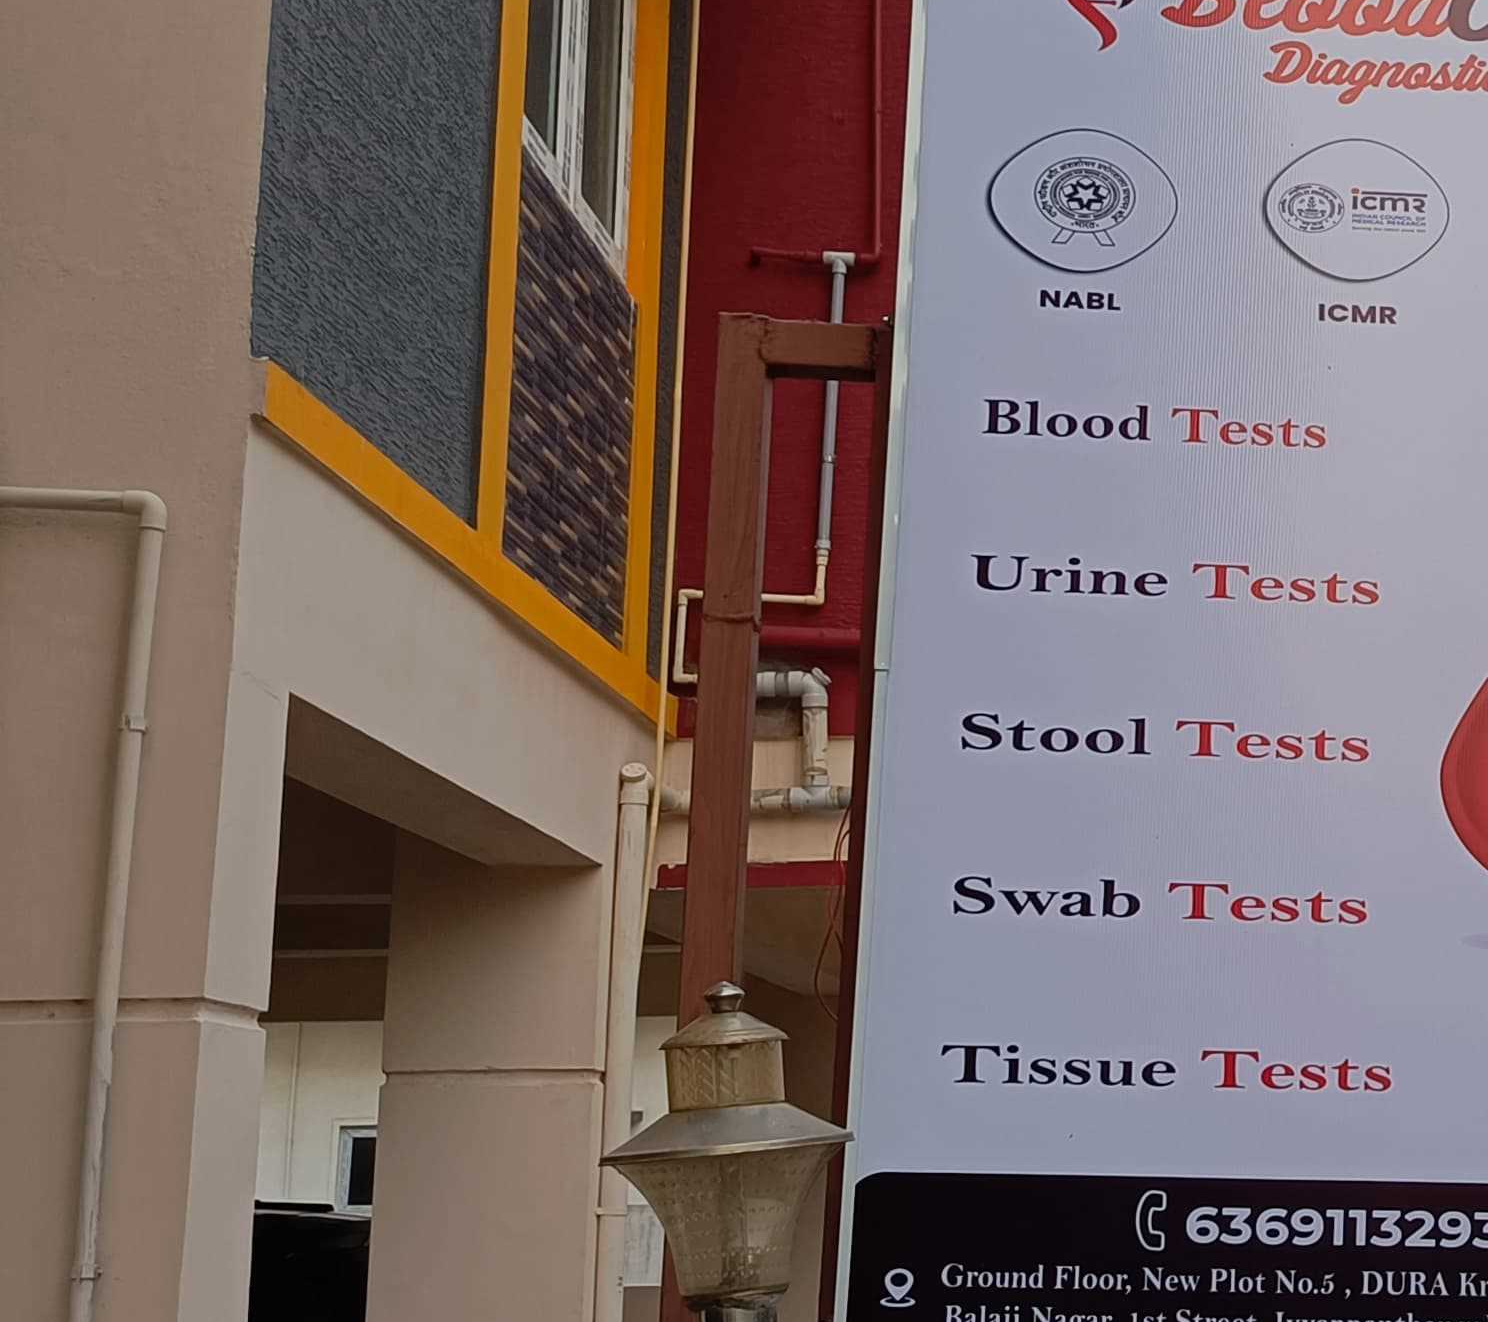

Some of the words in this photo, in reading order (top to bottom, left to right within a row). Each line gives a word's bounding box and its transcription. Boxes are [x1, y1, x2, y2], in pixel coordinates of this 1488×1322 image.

[1040, 290, 1121, 311] NABL
[1318, 303, 1397, 325] ICMR
[981, 399, 1151, 441] Blood
[1171, 407, 1327, 448] Tests
[971, 554, 1168, 597] Urine
[1192, 563, 1380, 605] Tests
[960, 713, 1152, 756] Stool
[1175, 720, 1371, 762] Tests
[952, 876, 1142, 919] Swab
[1168, 883, 1368, 924] Tests
[941, 1044, 1176, 1087] Tissue
[1200, 1050, 1393, 1092] Tests
[941, 1263, 1044, 1290] Ground
[1055, 1265, 1132, 1294] Floor,
[1142, 1267, 1200, 1293] New
[1209, 1268, 1265, 1294] Plot
[1275, 1270, 1335, 1295] No.5
[1361, 1270, 1449, 1296] DURA
